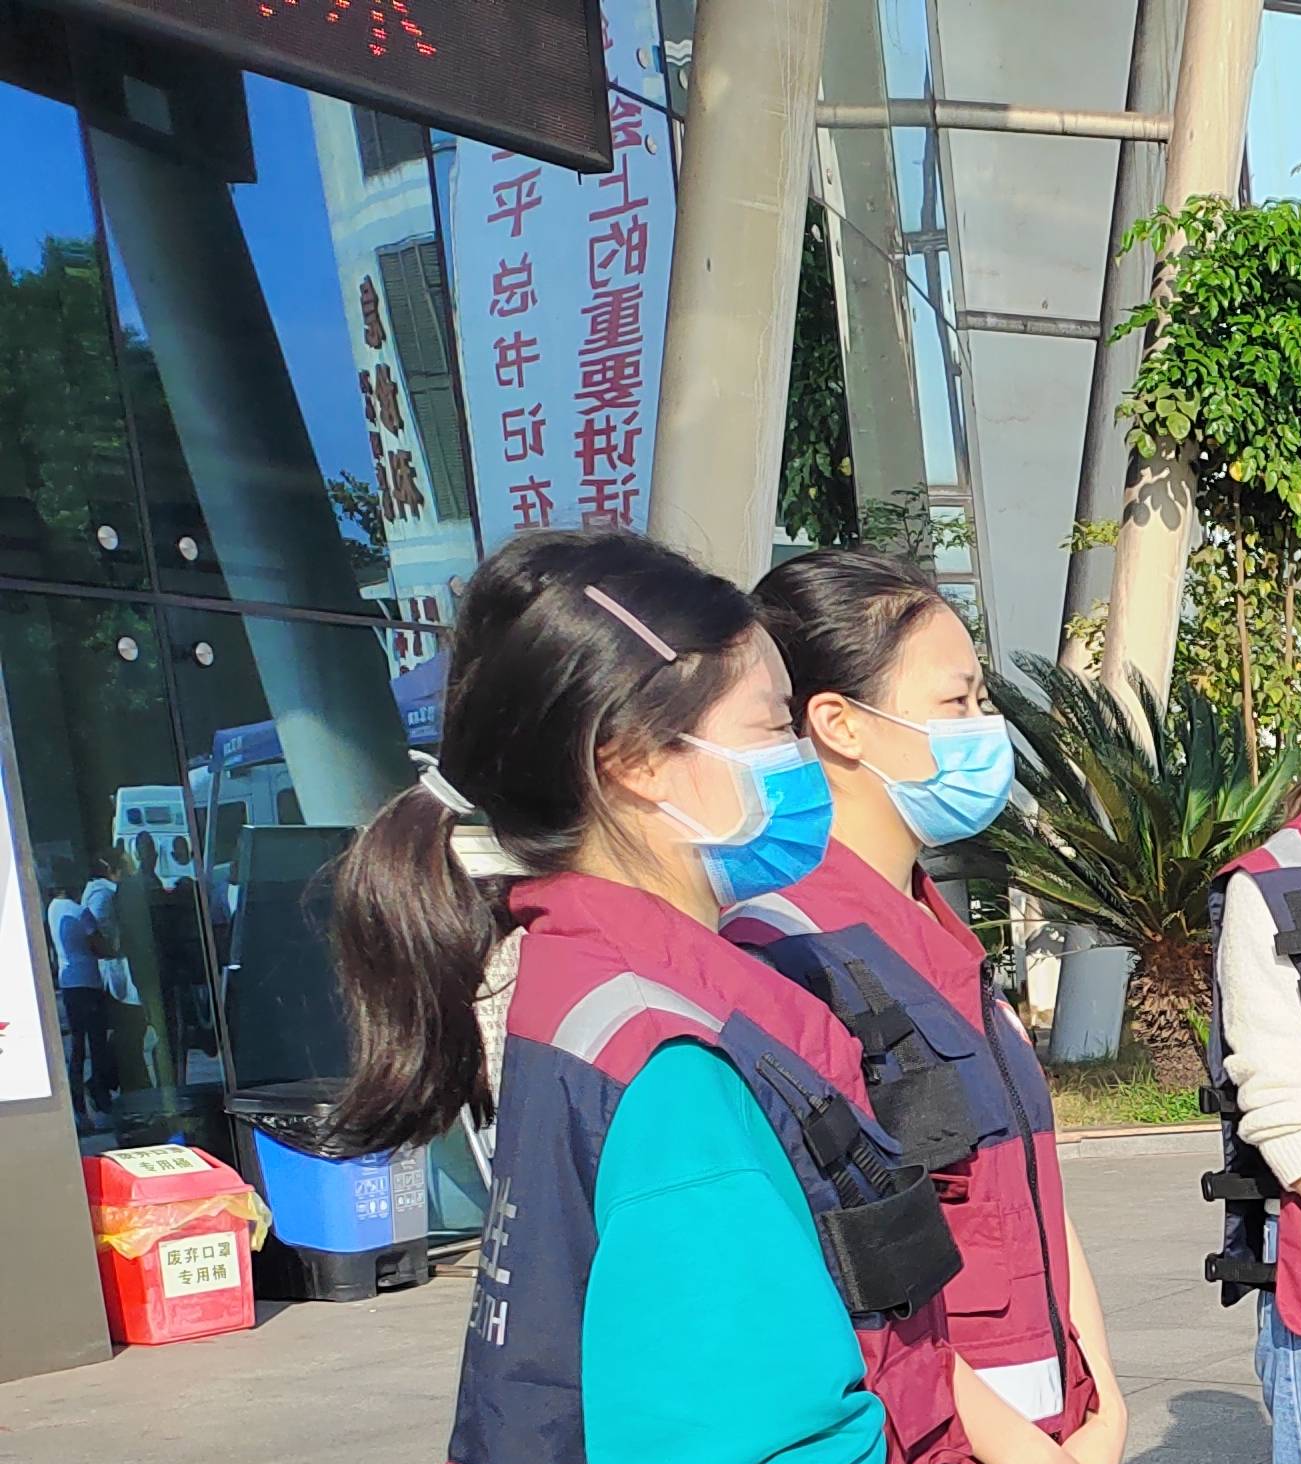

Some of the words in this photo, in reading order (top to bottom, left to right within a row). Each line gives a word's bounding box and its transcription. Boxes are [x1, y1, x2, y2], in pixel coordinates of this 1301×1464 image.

[167, 1241, 232, 1266] 废弃口罩
[178, 1264, 228, 1285] 专用桶
